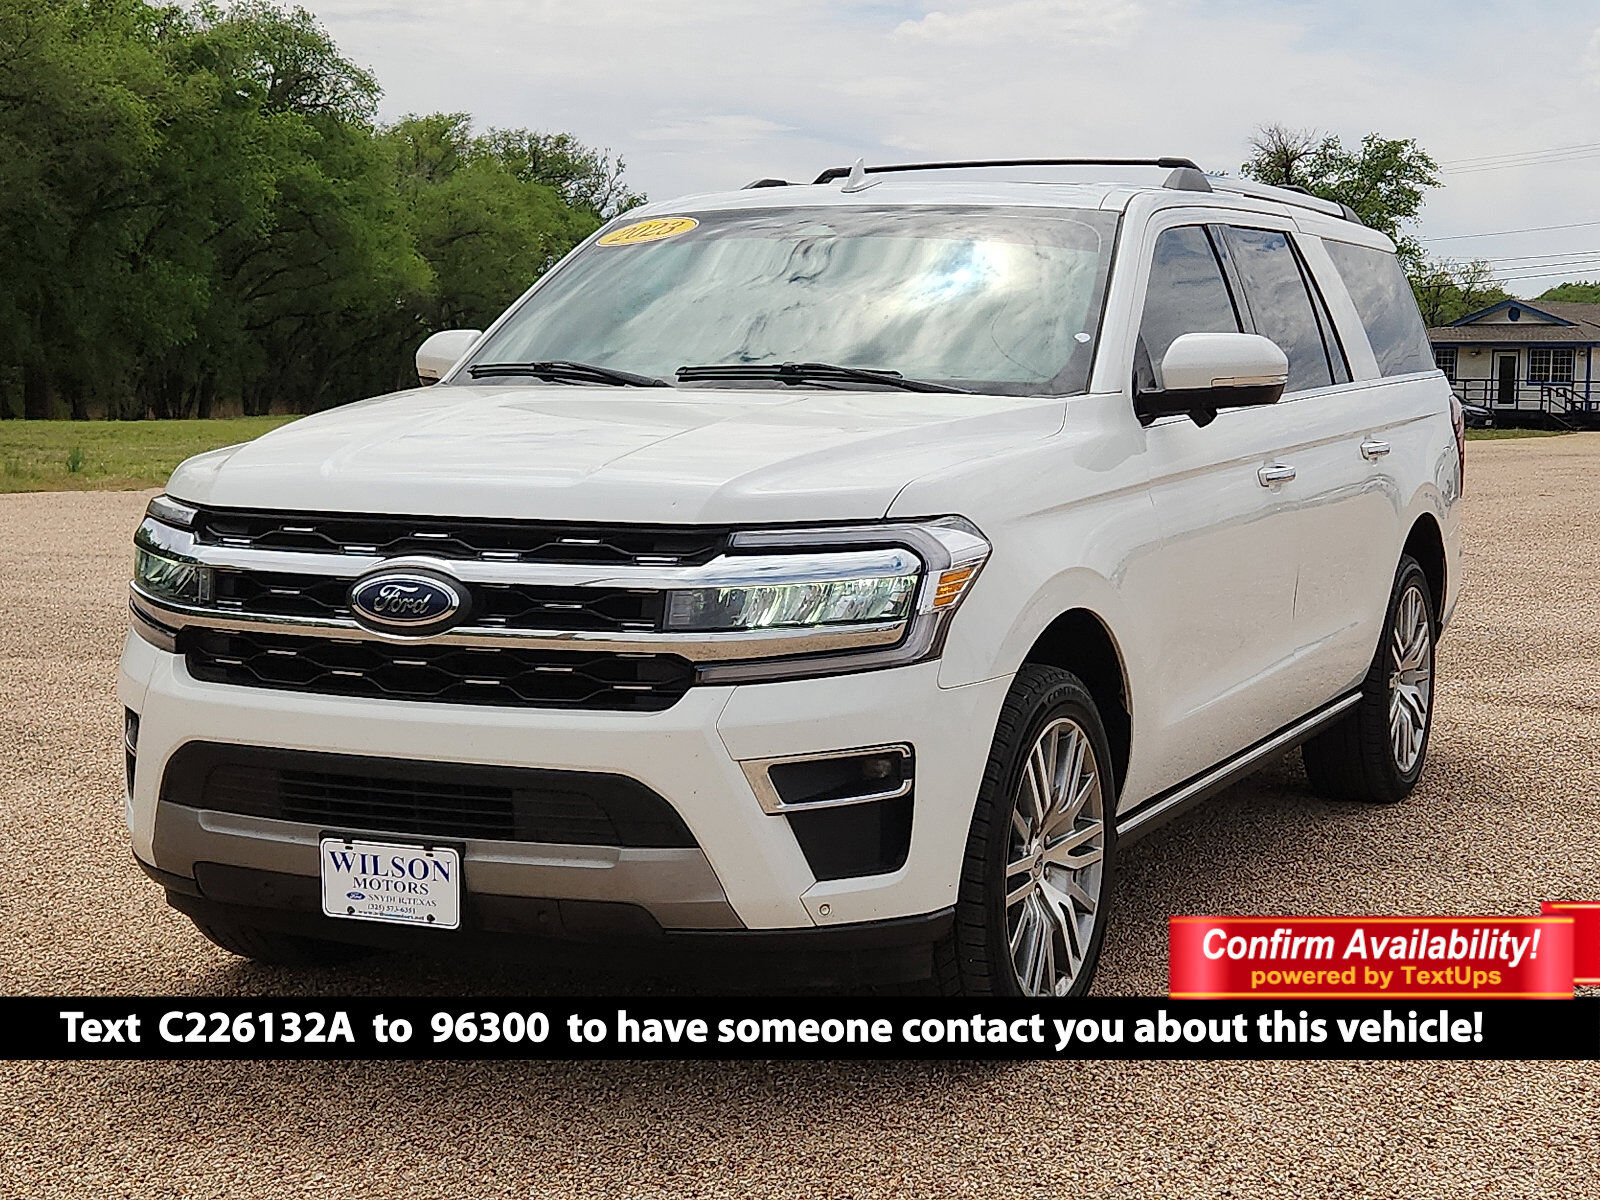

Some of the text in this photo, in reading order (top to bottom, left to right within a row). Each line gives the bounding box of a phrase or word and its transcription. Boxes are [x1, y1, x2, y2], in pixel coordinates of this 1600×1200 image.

[373, 584, 432, 614] Ford
[328, 850, 452, 883] WILSON
[352, 876, 430, 896] MOTORS
